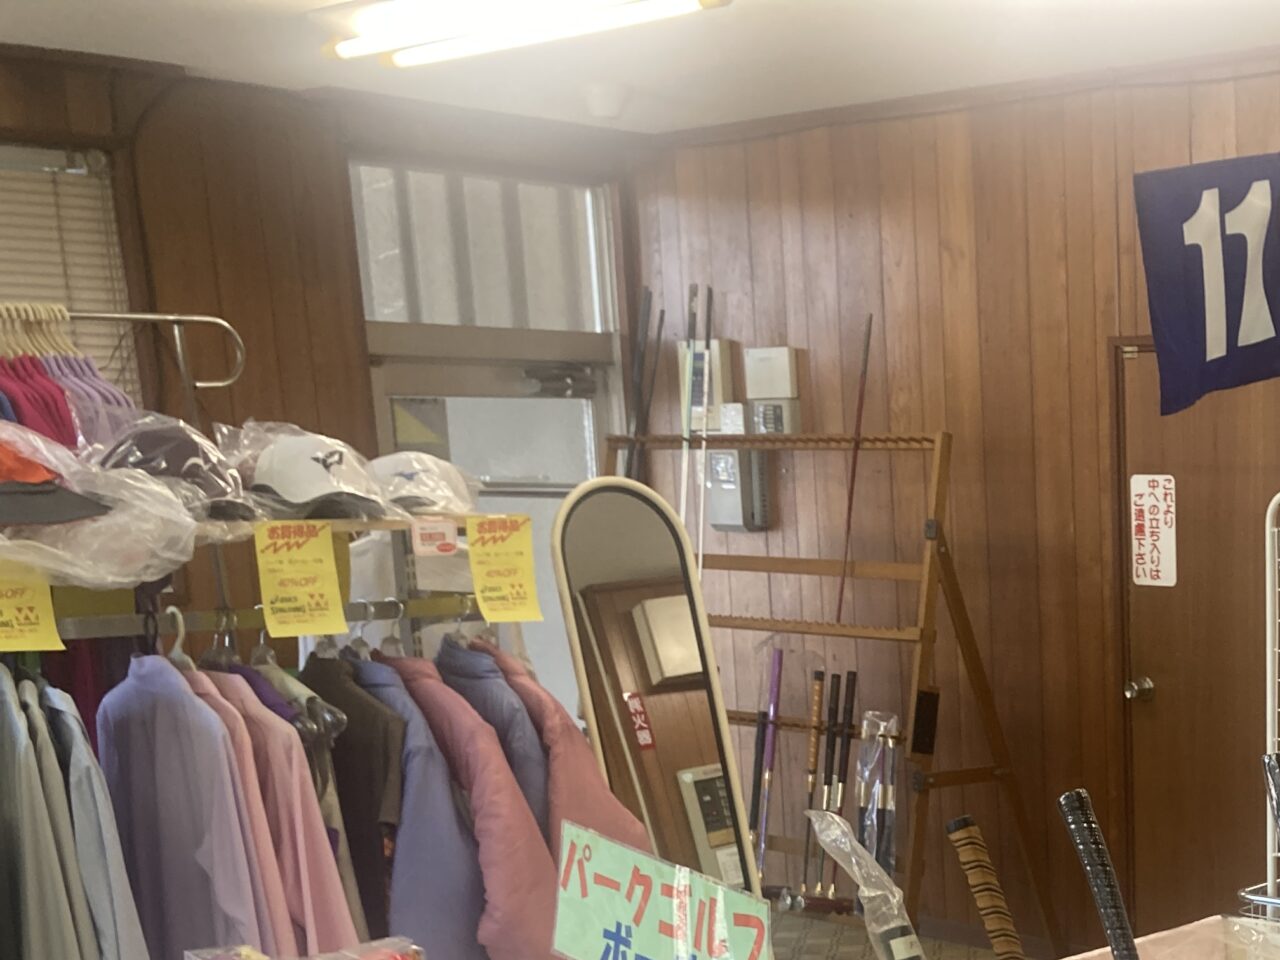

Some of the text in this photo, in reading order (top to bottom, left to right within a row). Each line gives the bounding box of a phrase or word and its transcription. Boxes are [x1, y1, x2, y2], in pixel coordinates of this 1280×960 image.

[1182, 179, 1276, 362] 11
[1134, 493, 1147, 578] ご遠慮下さい
[1148, 479, 1162, 580] 中への立ち入りは
[1163, 478, 1174, 528] これより
